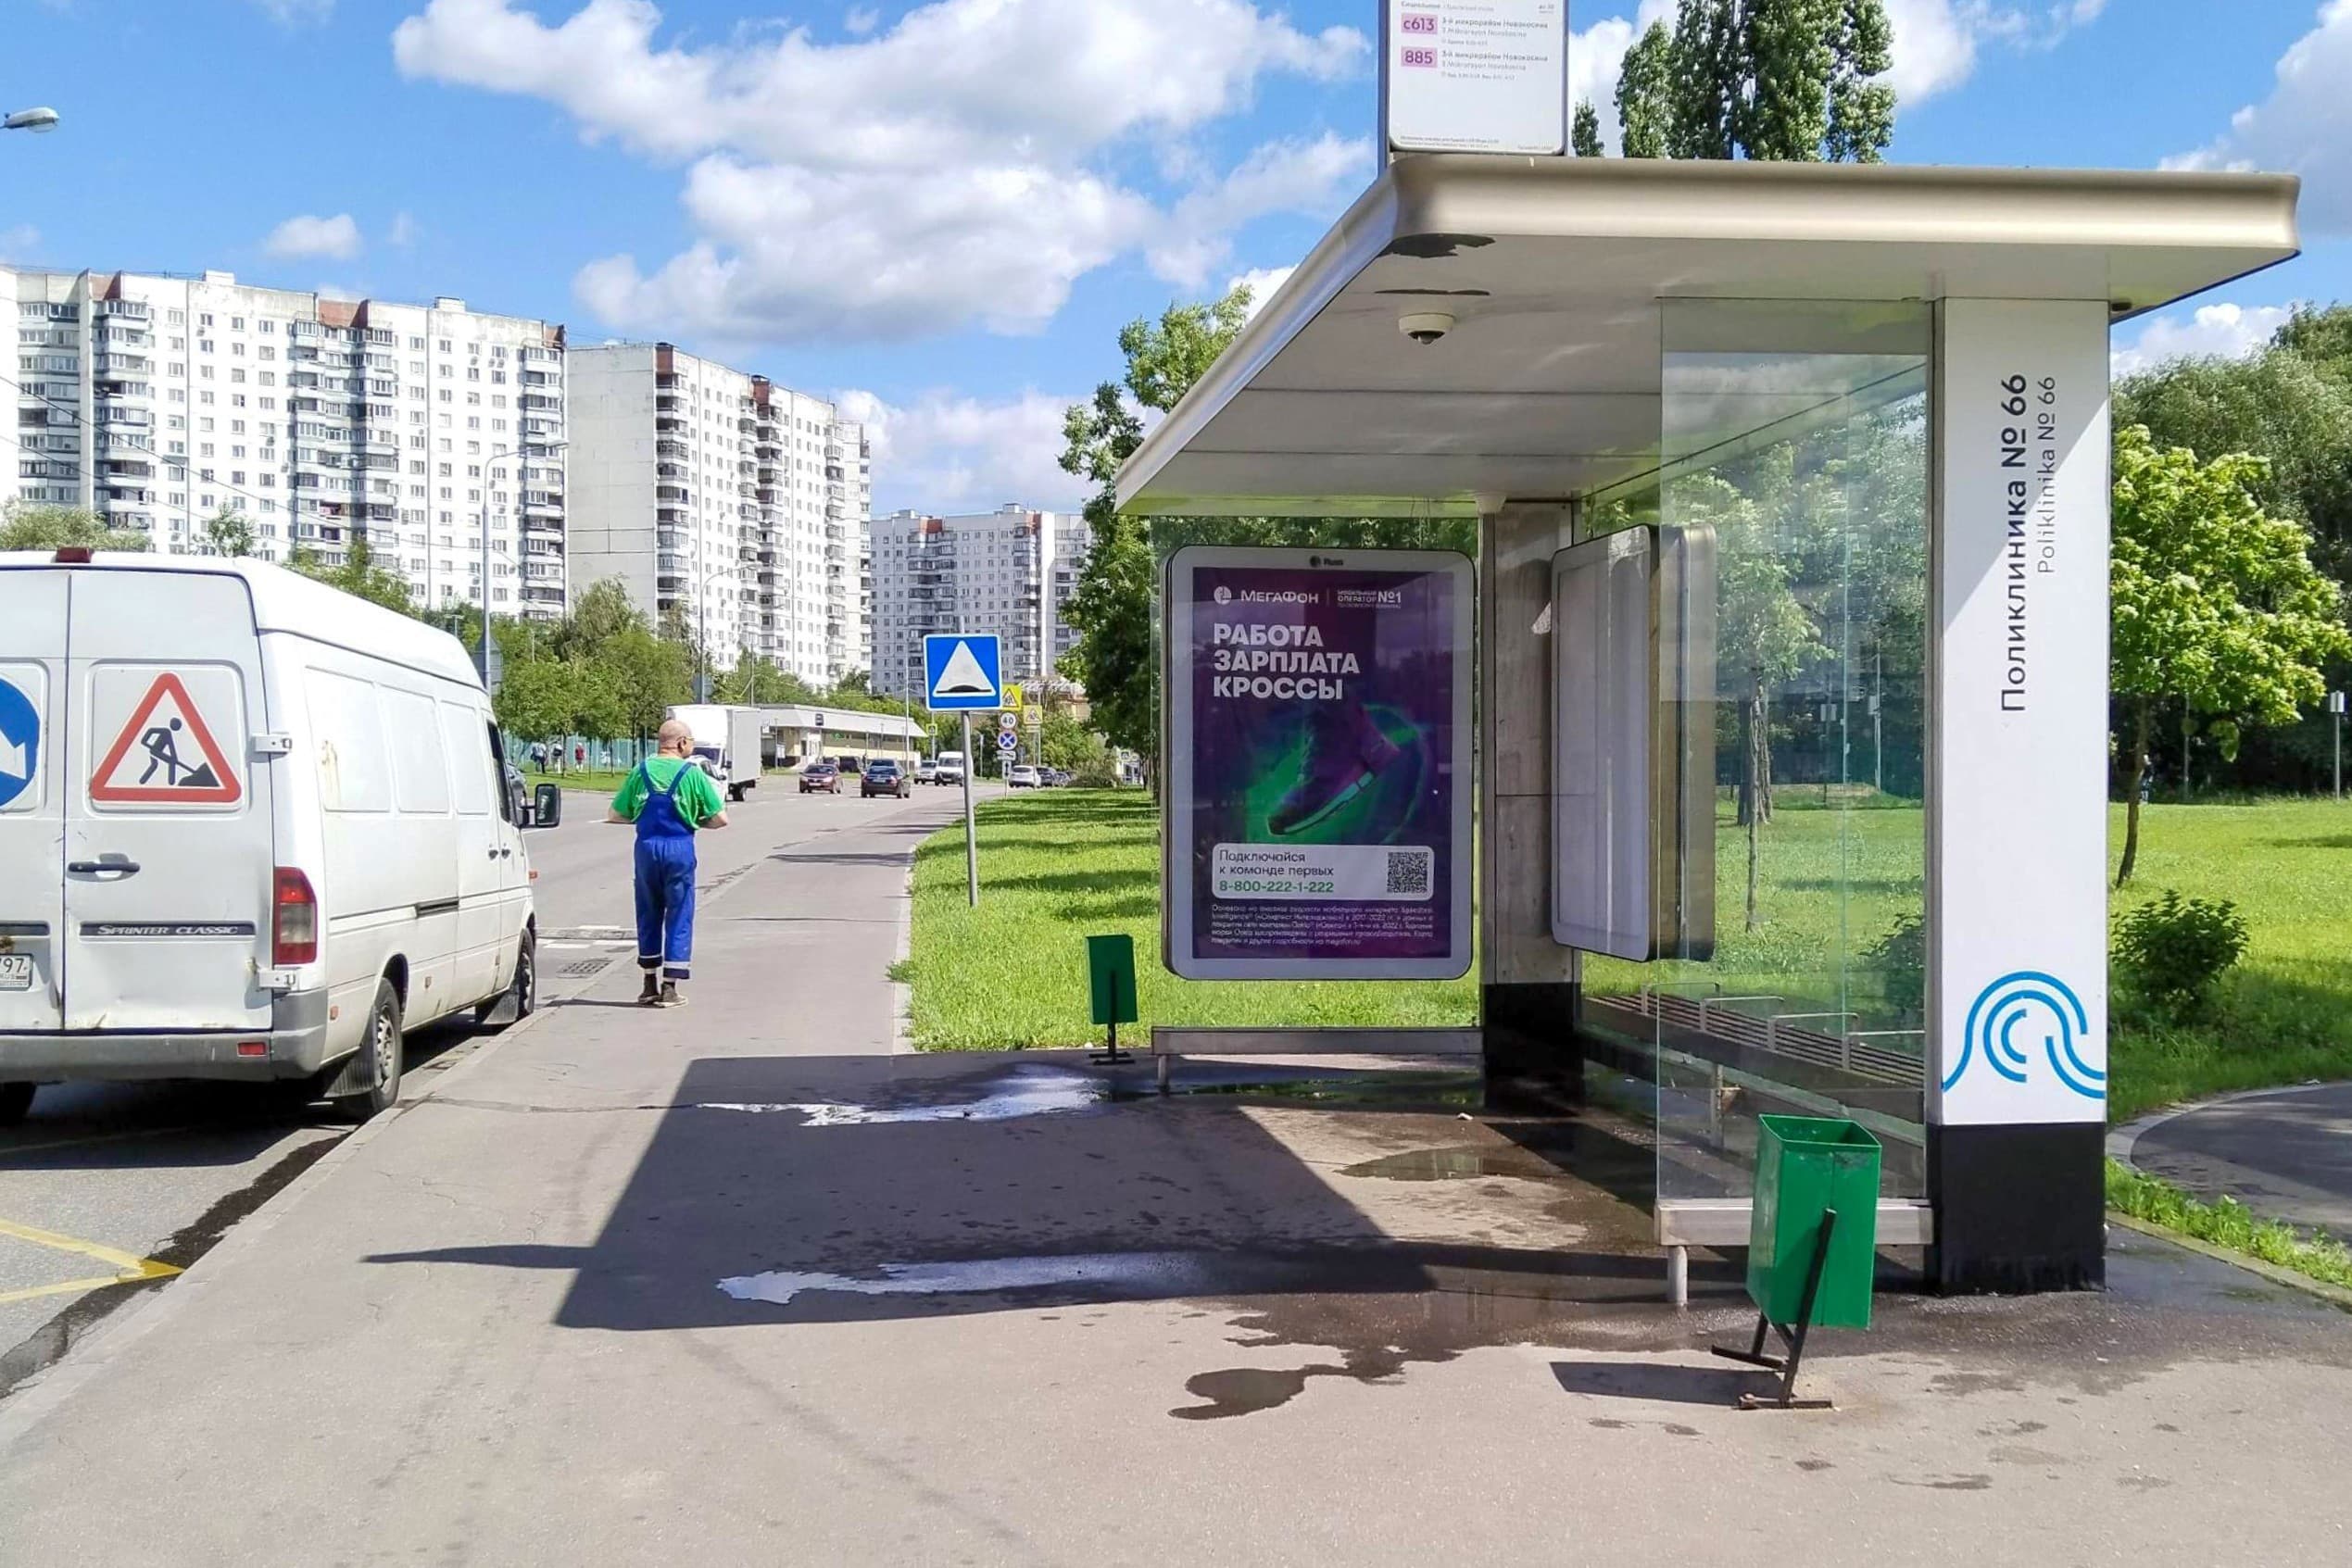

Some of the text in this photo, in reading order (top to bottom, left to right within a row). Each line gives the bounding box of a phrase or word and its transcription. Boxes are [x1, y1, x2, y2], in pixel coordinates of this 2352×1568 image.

[1404, 50, 1433, 64] 885
[2038, 376, 2056, 574] Poliklinika № 66
[2001, 374, 2028, 711] Поликлиника № 66
[1377, 590, 1402, 604] №1
[1214, 622, 1324, 646] РАБОТА
[1214, 648, 1361, 673] ЗАРПЛАТА
[1213, 675, 1343, 700] КРОССЫ
[1002, 716, 1014, 724] 40
[1219, 849, 1306, 863] Подключайся
[1219, 866, 1335, 878] к команде первых
[1219, 880, 1335, 893] 8-800-222-1-222
[97, 925, 238, 935] SPRINTER CLASSIC
[0, 958, 24, 972] 97
